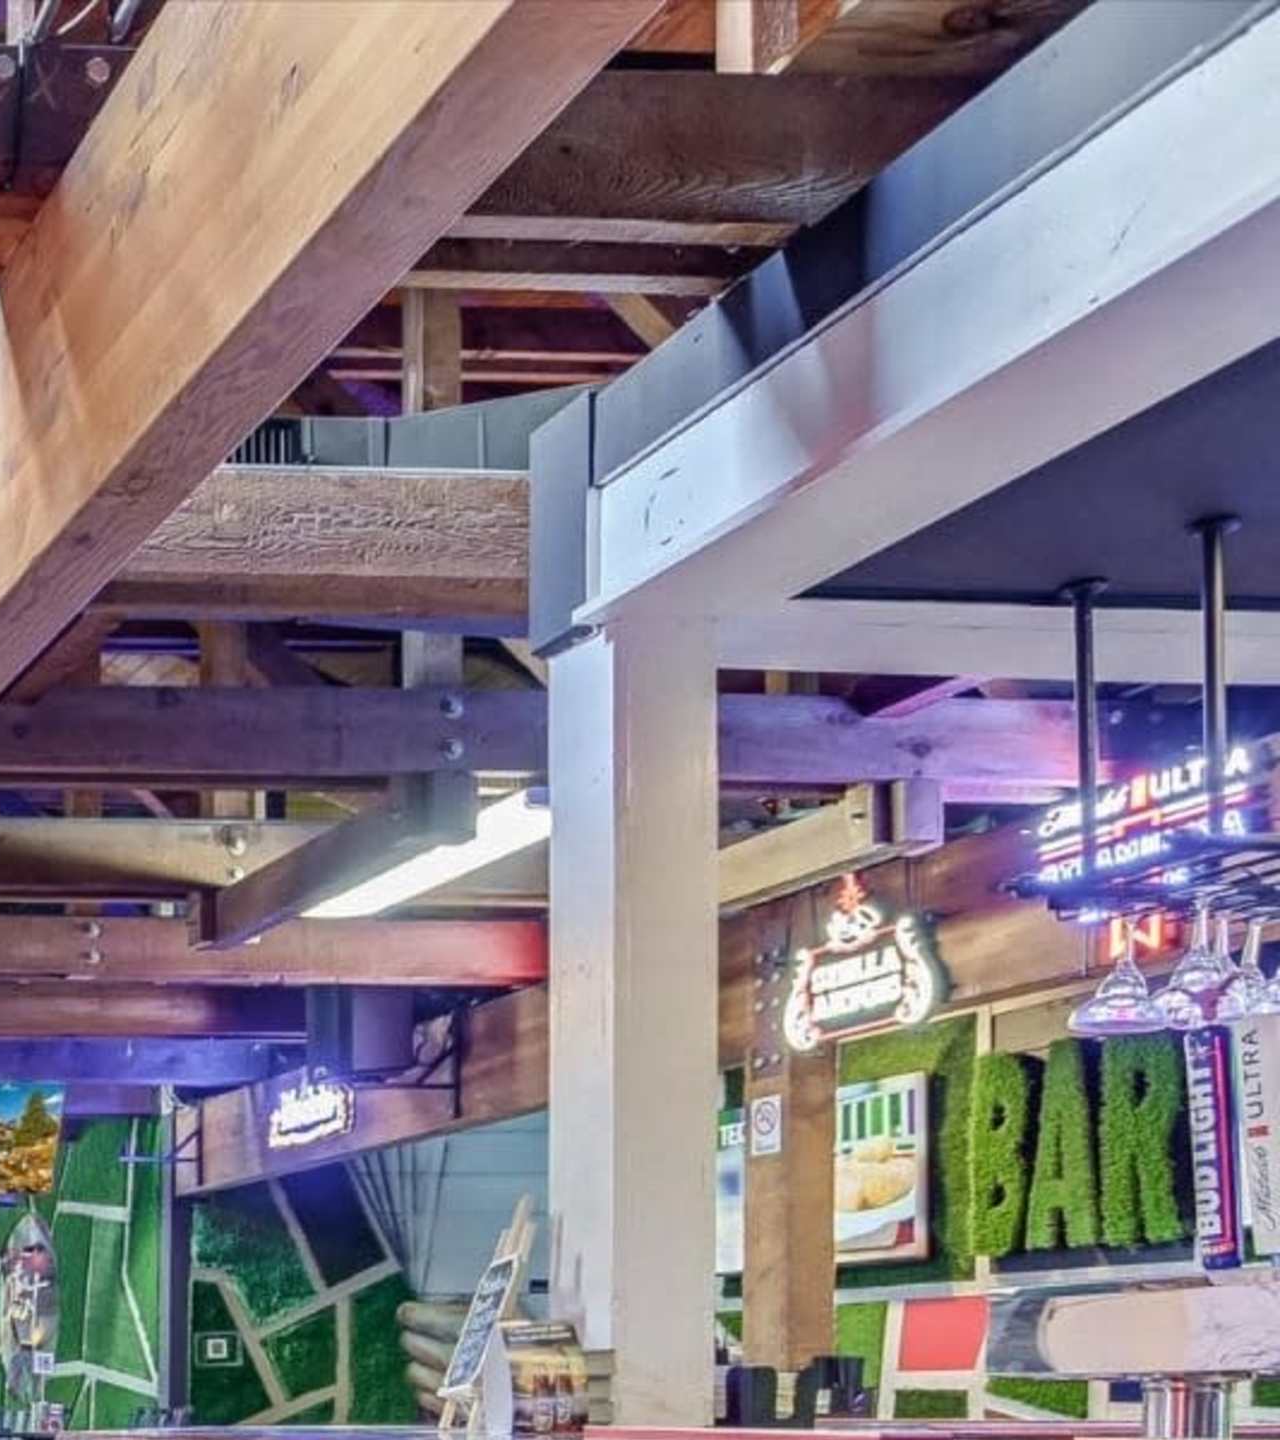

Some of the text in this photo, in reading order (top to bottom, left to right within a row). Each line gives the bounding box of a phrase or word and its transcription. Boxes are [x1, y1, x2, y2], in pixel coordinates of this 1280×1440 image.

[1150, 747, 1252, 798] ULTA
[1241, 1027, 1265, 1120] ULTRA
[971, 1034, 1184, 1257] BAR
[1187, 1063, 1223, 1238] BUD LIGHT
